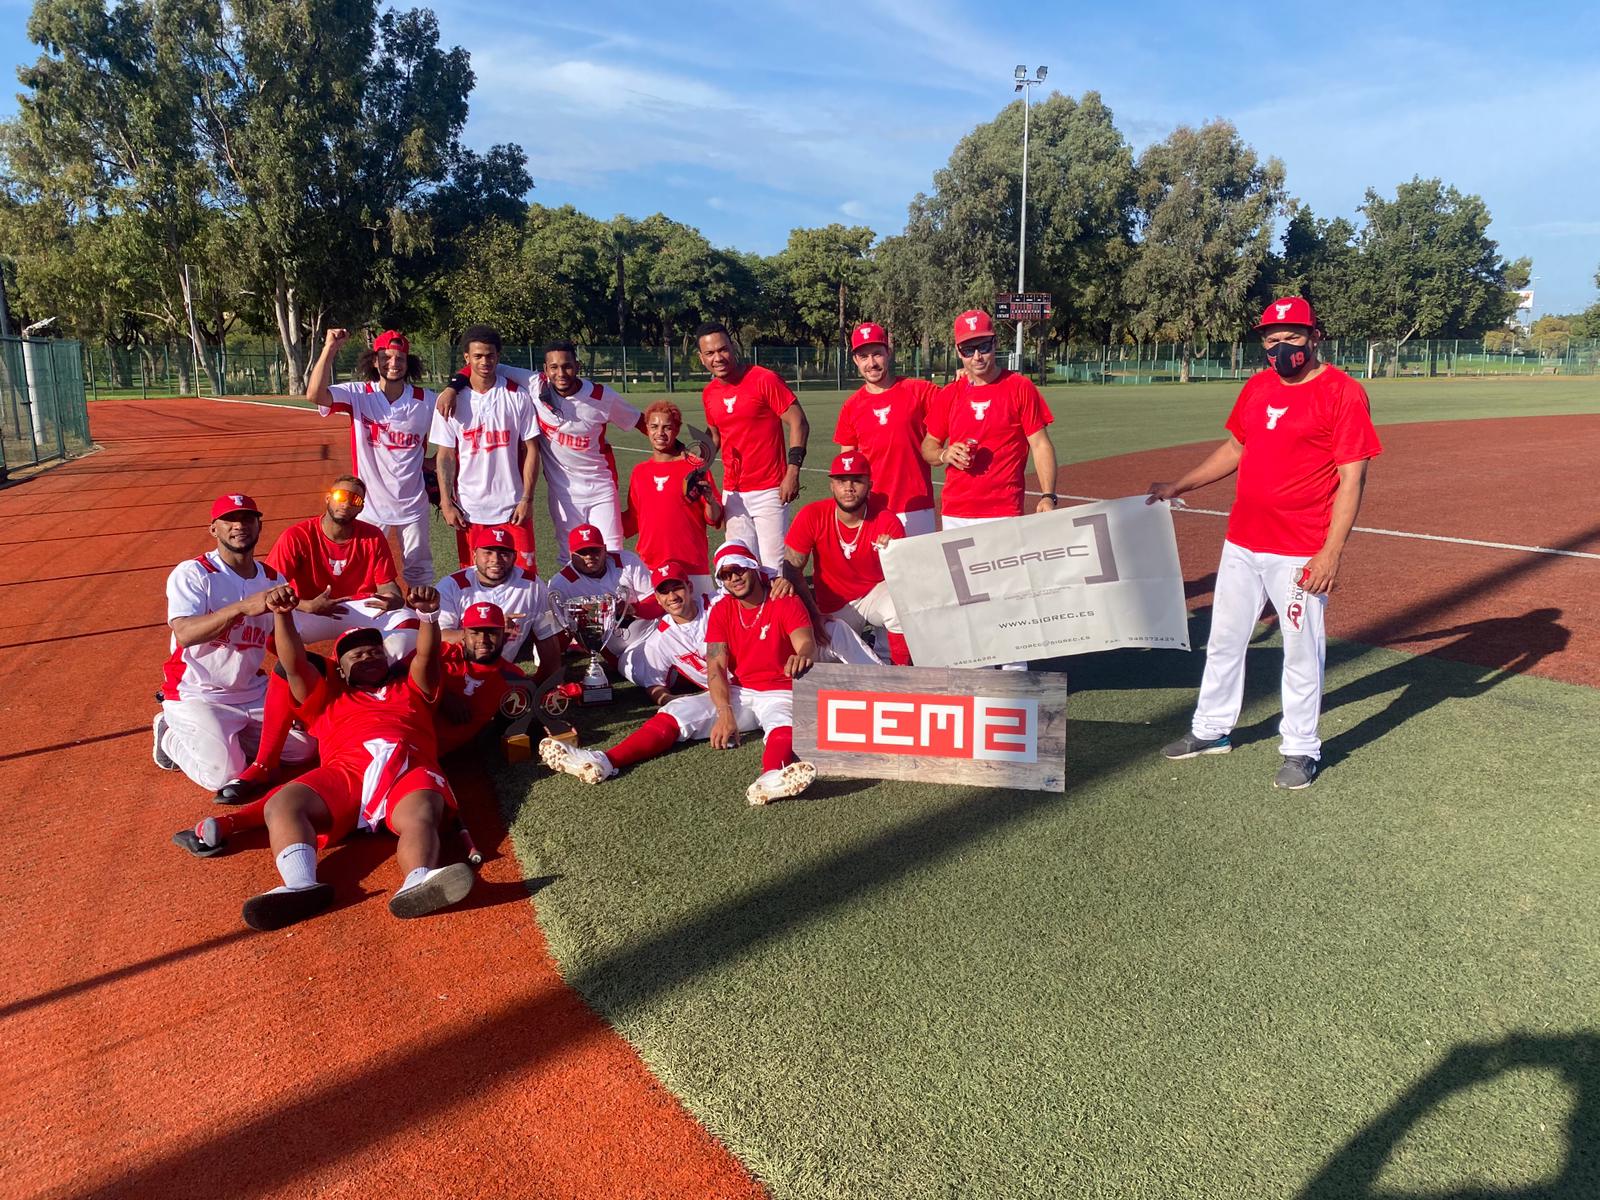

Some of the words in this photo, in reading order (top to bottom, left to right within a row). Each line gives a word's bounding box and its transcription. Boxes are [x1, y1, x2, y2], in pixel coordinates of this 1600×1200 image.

[1290, 351, 1305, 369] 19
[968, 546, 1090, 575] SIGREC
[998, 610, 1096, 630] WWW.SIGREC.ES
[827, 699, 1027, 752] CEM2
